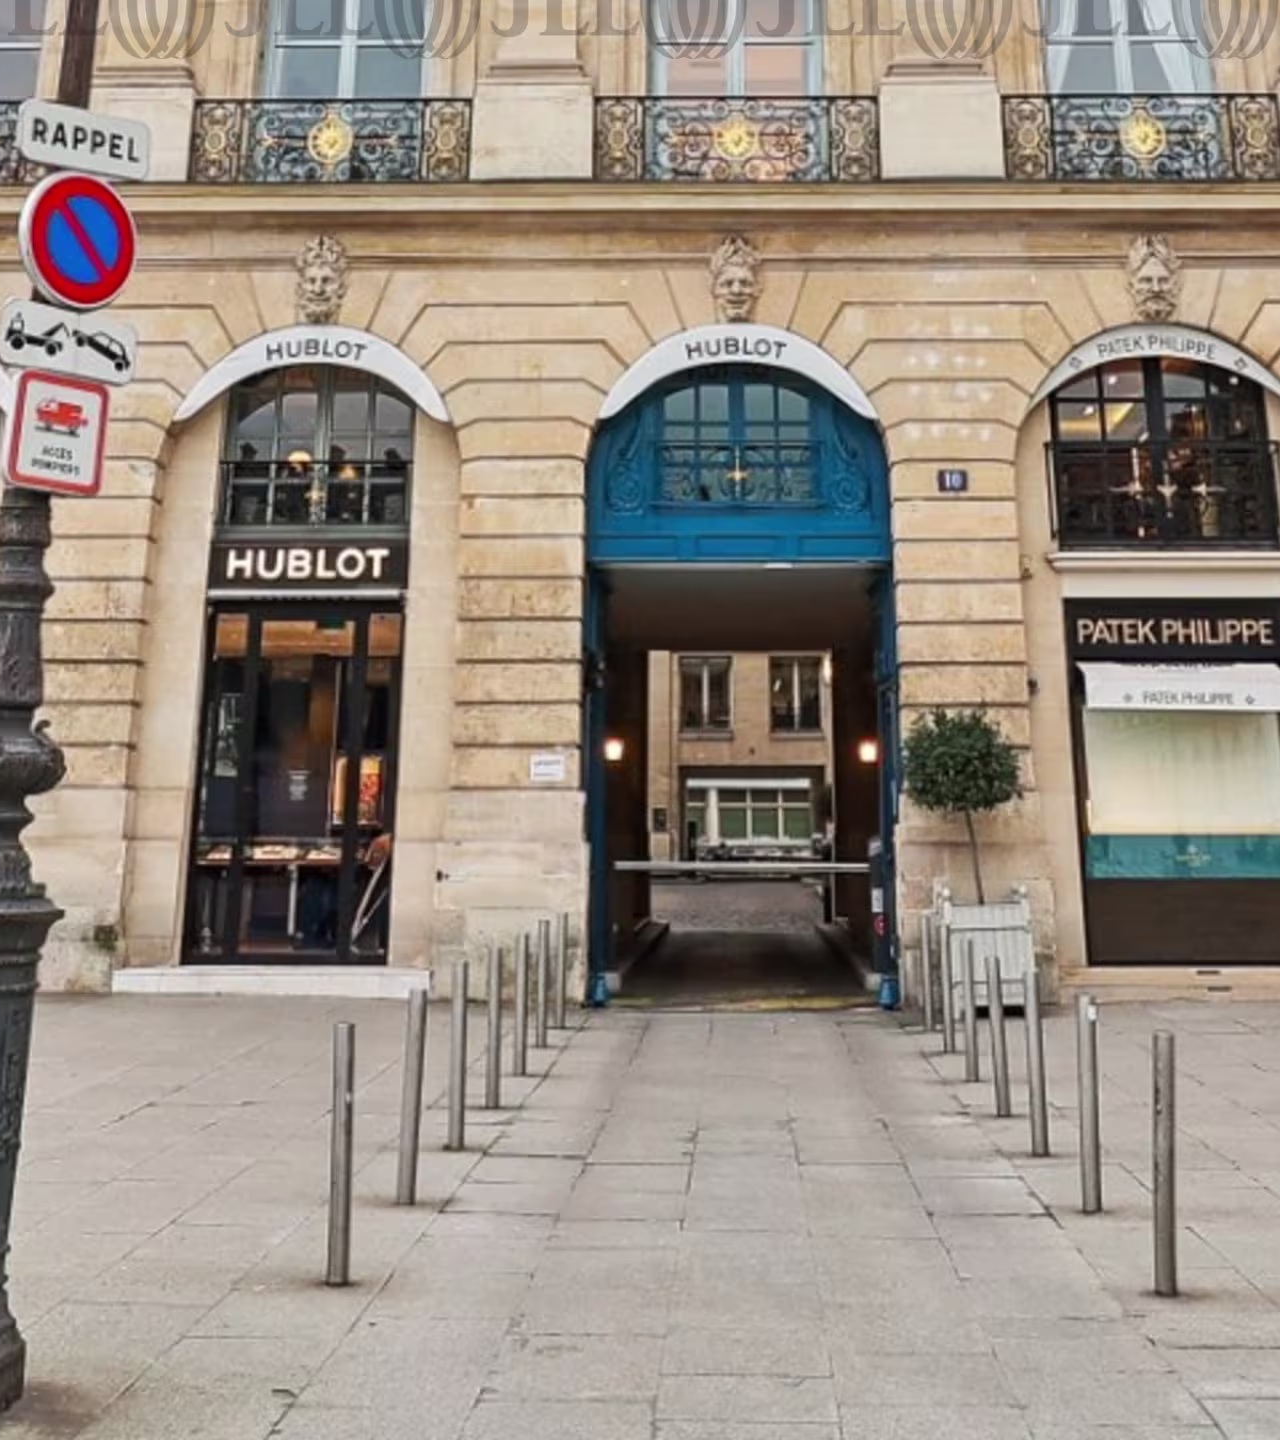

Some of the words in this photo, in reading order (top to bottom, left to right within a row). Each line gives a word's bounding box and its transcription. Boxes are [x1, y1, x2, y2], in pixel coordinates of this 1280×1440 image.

[32, 117, 140, 164] RAPPEL
[265, 338, 368, 361] HUBLOT
[685, 336, 788, 360] HUBLOT
[1096, 335, 1145, 358] PATEK
[1148, 334, 1217, 360] PHILIPPE
[226, 547, 390, 580] HUBLOT
[1076, 618, 1157, 645] PATEK
[1160, 618, 1274, 646] PHILIPPE
